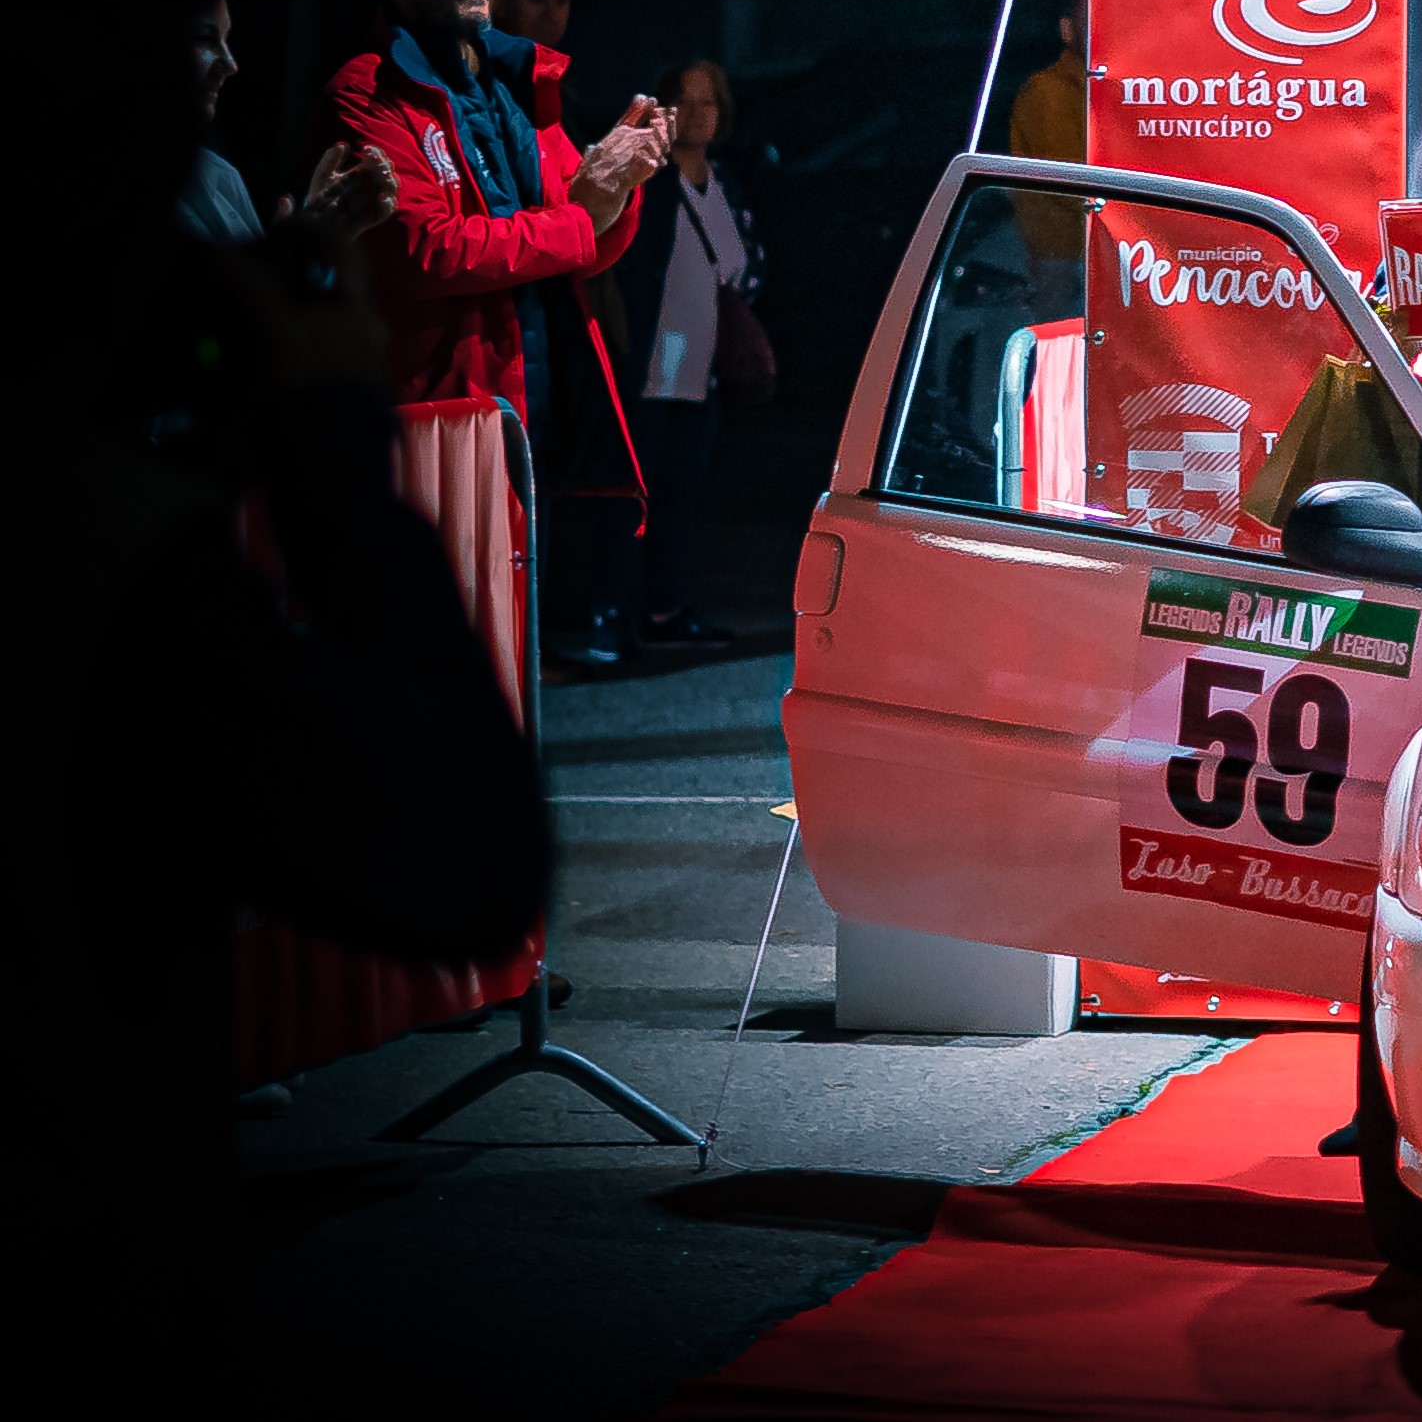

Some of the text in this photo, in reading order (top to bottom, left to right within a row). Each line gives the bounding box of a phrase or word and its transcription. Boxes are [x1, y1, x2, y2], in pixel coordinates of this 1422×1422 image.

[1121, 69, 1367, 121] mortágua
[1137, 116, 1272, 139] MUNICÍPIO
[1178, 246, 1262, 265] município
[1148, 590, 1409, 665] LEGENDS RALLY LEGENDS
[1166, 656, 1351, 847] 59
[1127, 837, 1216, 885] Luso
